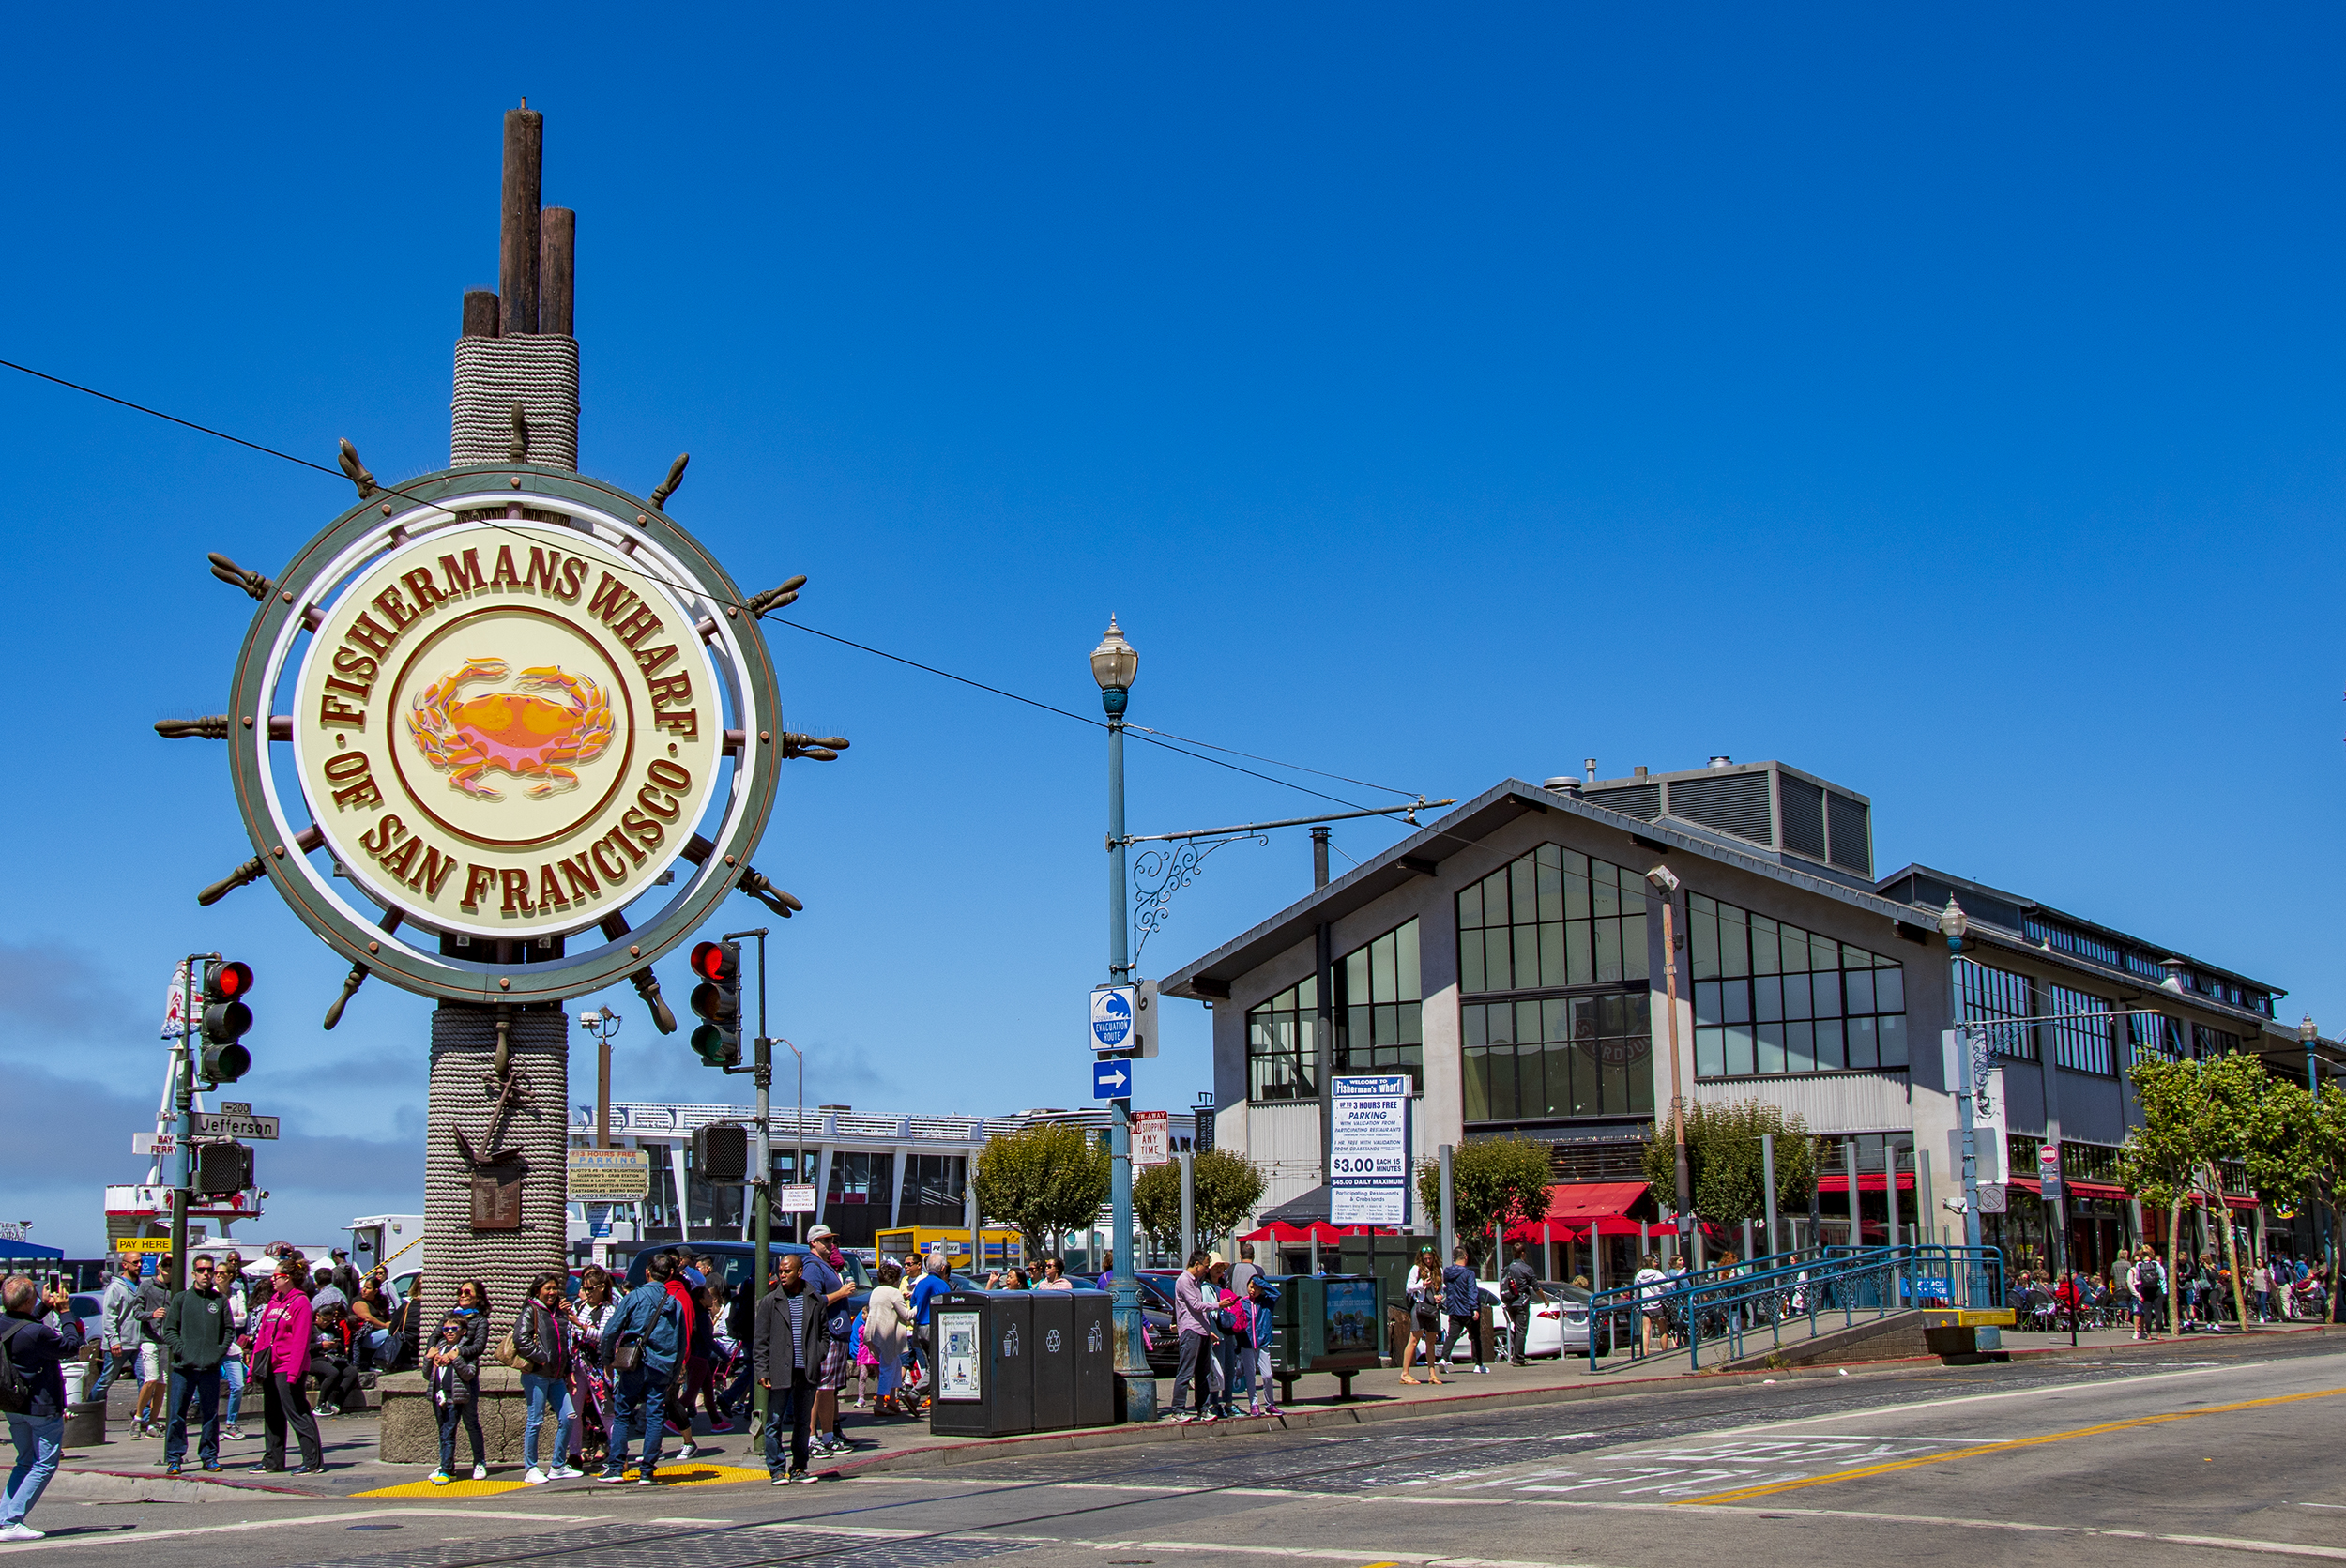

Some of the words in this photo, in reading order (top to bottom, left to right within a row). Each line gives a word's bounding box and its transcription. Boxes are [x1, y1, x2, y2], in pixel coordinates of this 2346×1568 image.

[320, 544, 589, 733] FISHERMANS
[586, 571, 699, 741] WHARF
[323, 750, 384, 812] OF
[358, 814, 457, 901] SAN
[459, 758, 693, 918] FRANCISCO
[1096, 1020, 1128, 1032] EVACUATION
[1104, 1031, 1120, 1042] ROUTE
[1336, 1080, 1377, 1094] Fisherman's
[1379, 1078, 1400, 1093] Wharf
[232, 1104, 250, 1113] 200
[1382, 1101, 1397, 1109] FREE
[1348, 1111, 1387, 1119] PARKING
[200, 1118, 272, 1134] Jefferson
[1131, 1120, 1141, 1134] NO
[1142, 1122, 1165, 1133] STOPPING
[158, 1135, 174, 1144] BAY
[1142, 1134, 1157, 1144] ANY
[150, 1145, 176, 1154] FERRY
[1141, 1145, 1158, 1155] TIME
[1333, 1158, 1374, 1173] $3.00
[119, 1241, 137, 1249] PAY
[142, 1241, 169, 1249] HERE
